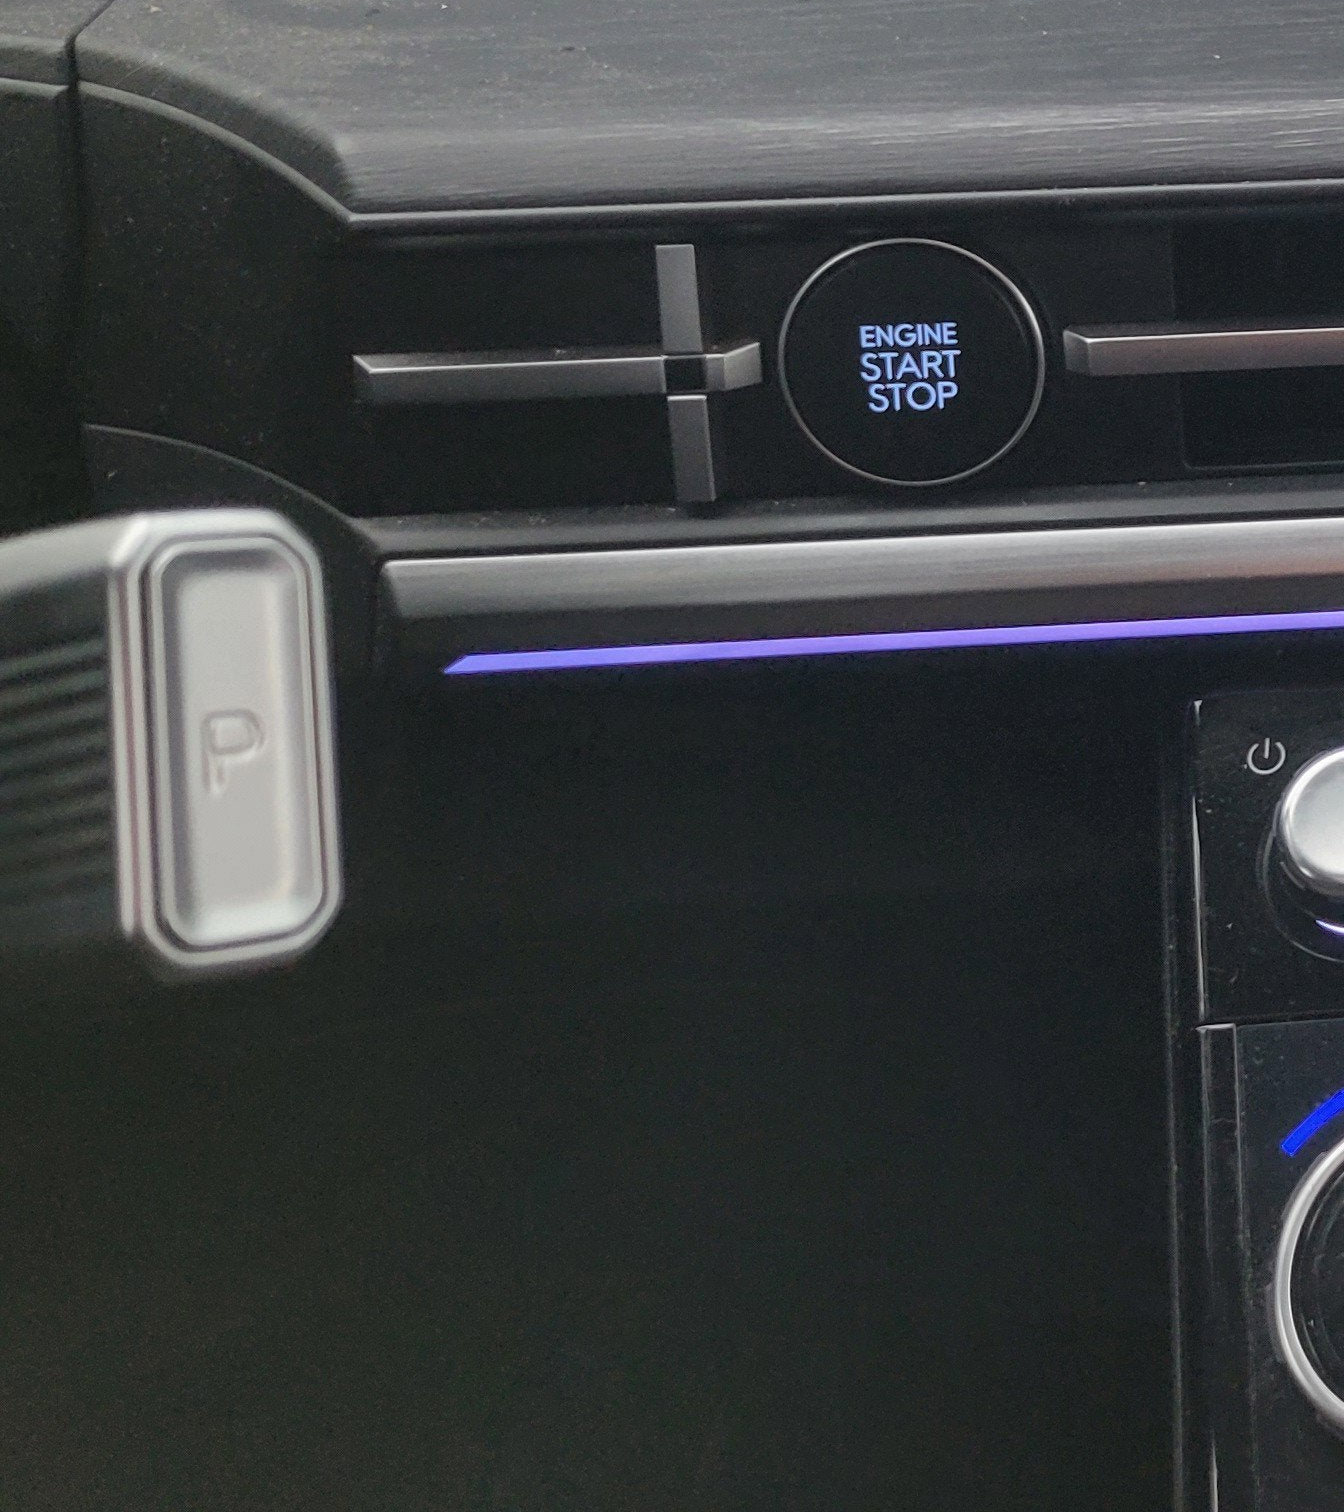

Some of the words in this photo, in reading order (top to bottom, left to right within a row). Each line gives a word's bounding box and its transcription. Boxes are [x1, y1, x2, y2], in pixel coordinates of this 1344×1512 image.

[858, 321, 960, 349] ENGINE
[859, 349, 962, 382] START
[867, 380, 960, 414] STOP
[202, 707, 266, 796] P
